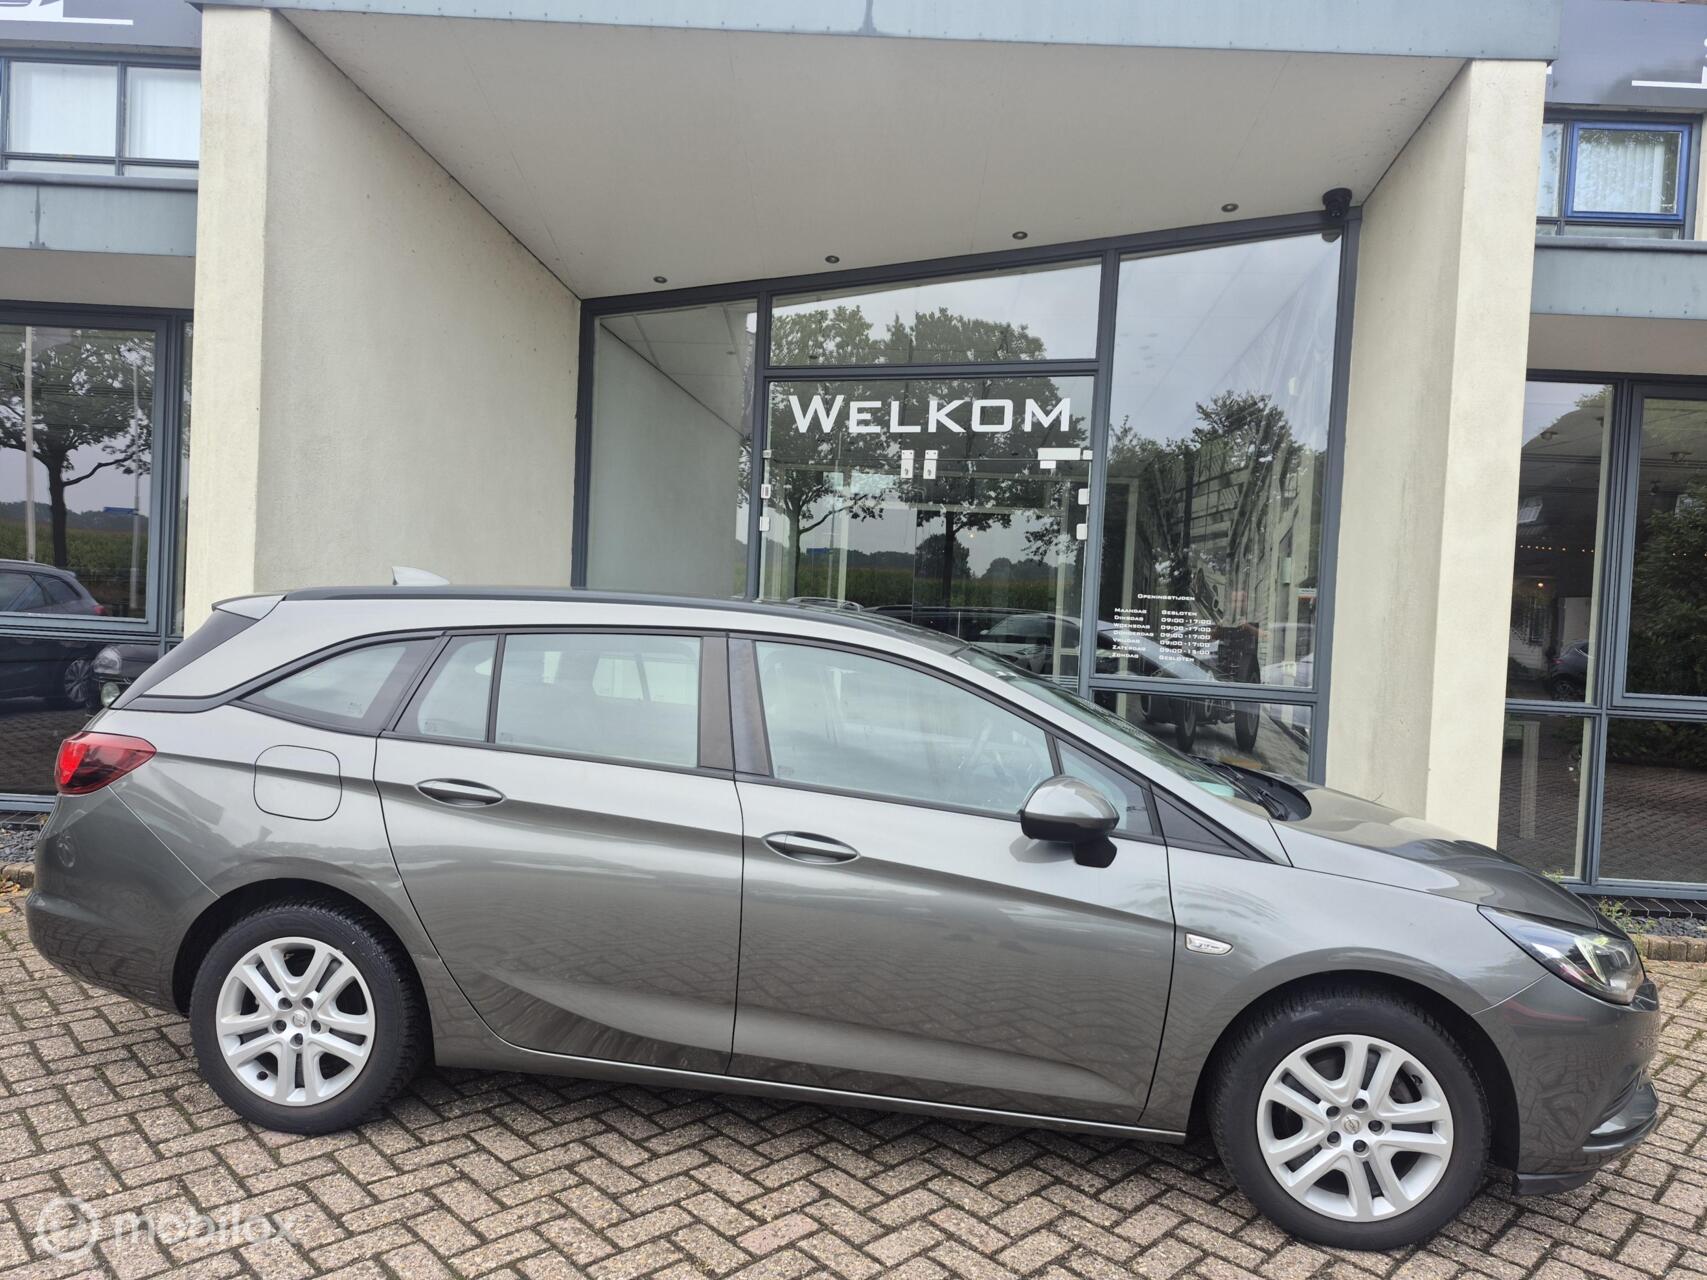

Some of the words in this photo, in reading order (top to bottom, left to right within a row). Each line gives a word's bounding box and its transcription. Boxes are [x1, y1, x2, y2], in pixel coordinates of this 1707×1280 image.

[788, 395, 1071, 433] WELKOM
[1114, 607, 1148, 615] MAANDAG
[1161, 609, 1198, 617] GESLOTEN
[1113, 614, 1144, 622] DINSDAG
[1113, 622, 1151, 630] WOENSDAG
